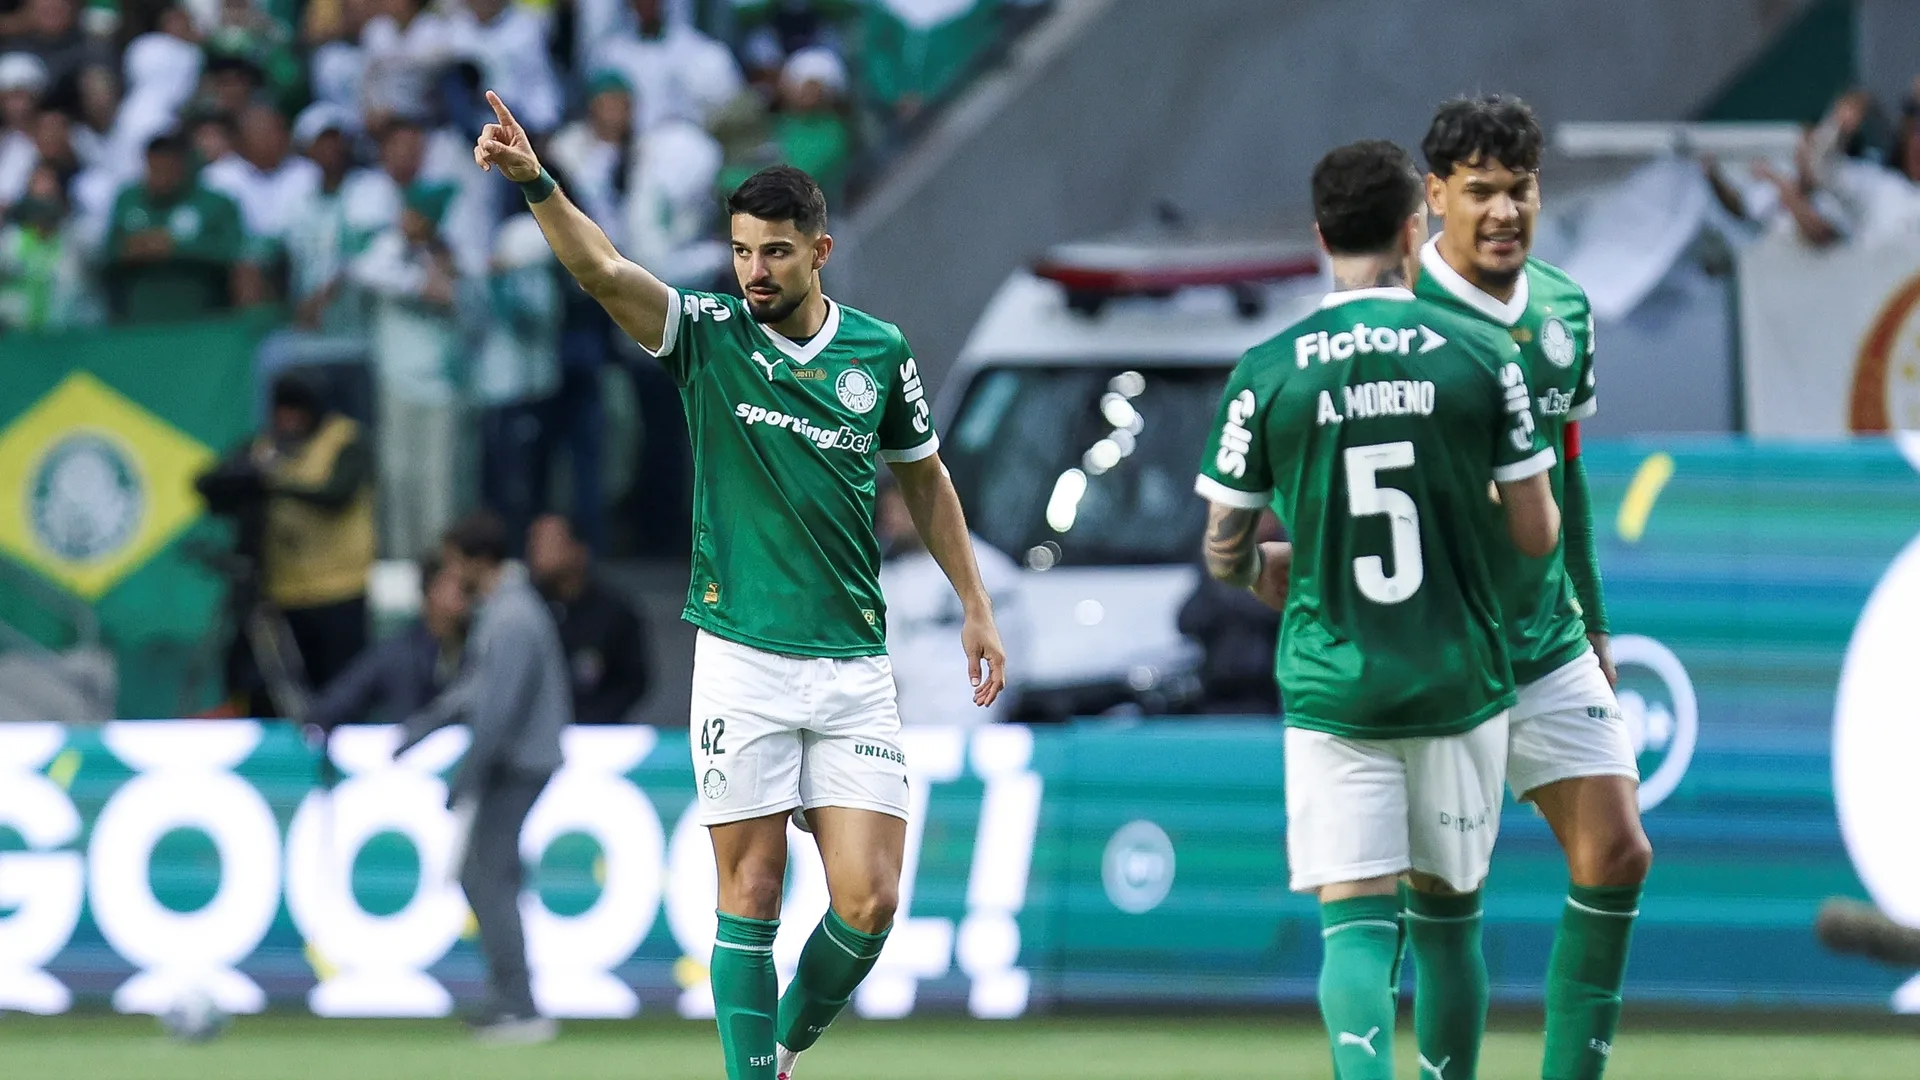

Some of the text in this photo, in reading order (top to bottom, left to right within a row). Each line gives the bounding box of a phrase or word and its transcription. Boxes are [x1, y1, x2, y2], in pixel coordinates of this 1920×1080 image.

[1295, 322, 1417, 370] Fictor
[1316, 380, 1436, 426] A. MORENO
[735, 402, 874, 454] sportingbet
[1344, 441, 1424, 604] 5
[701, 718, 726, 756] 42
[750, 1054, 774, 1067] SEP
